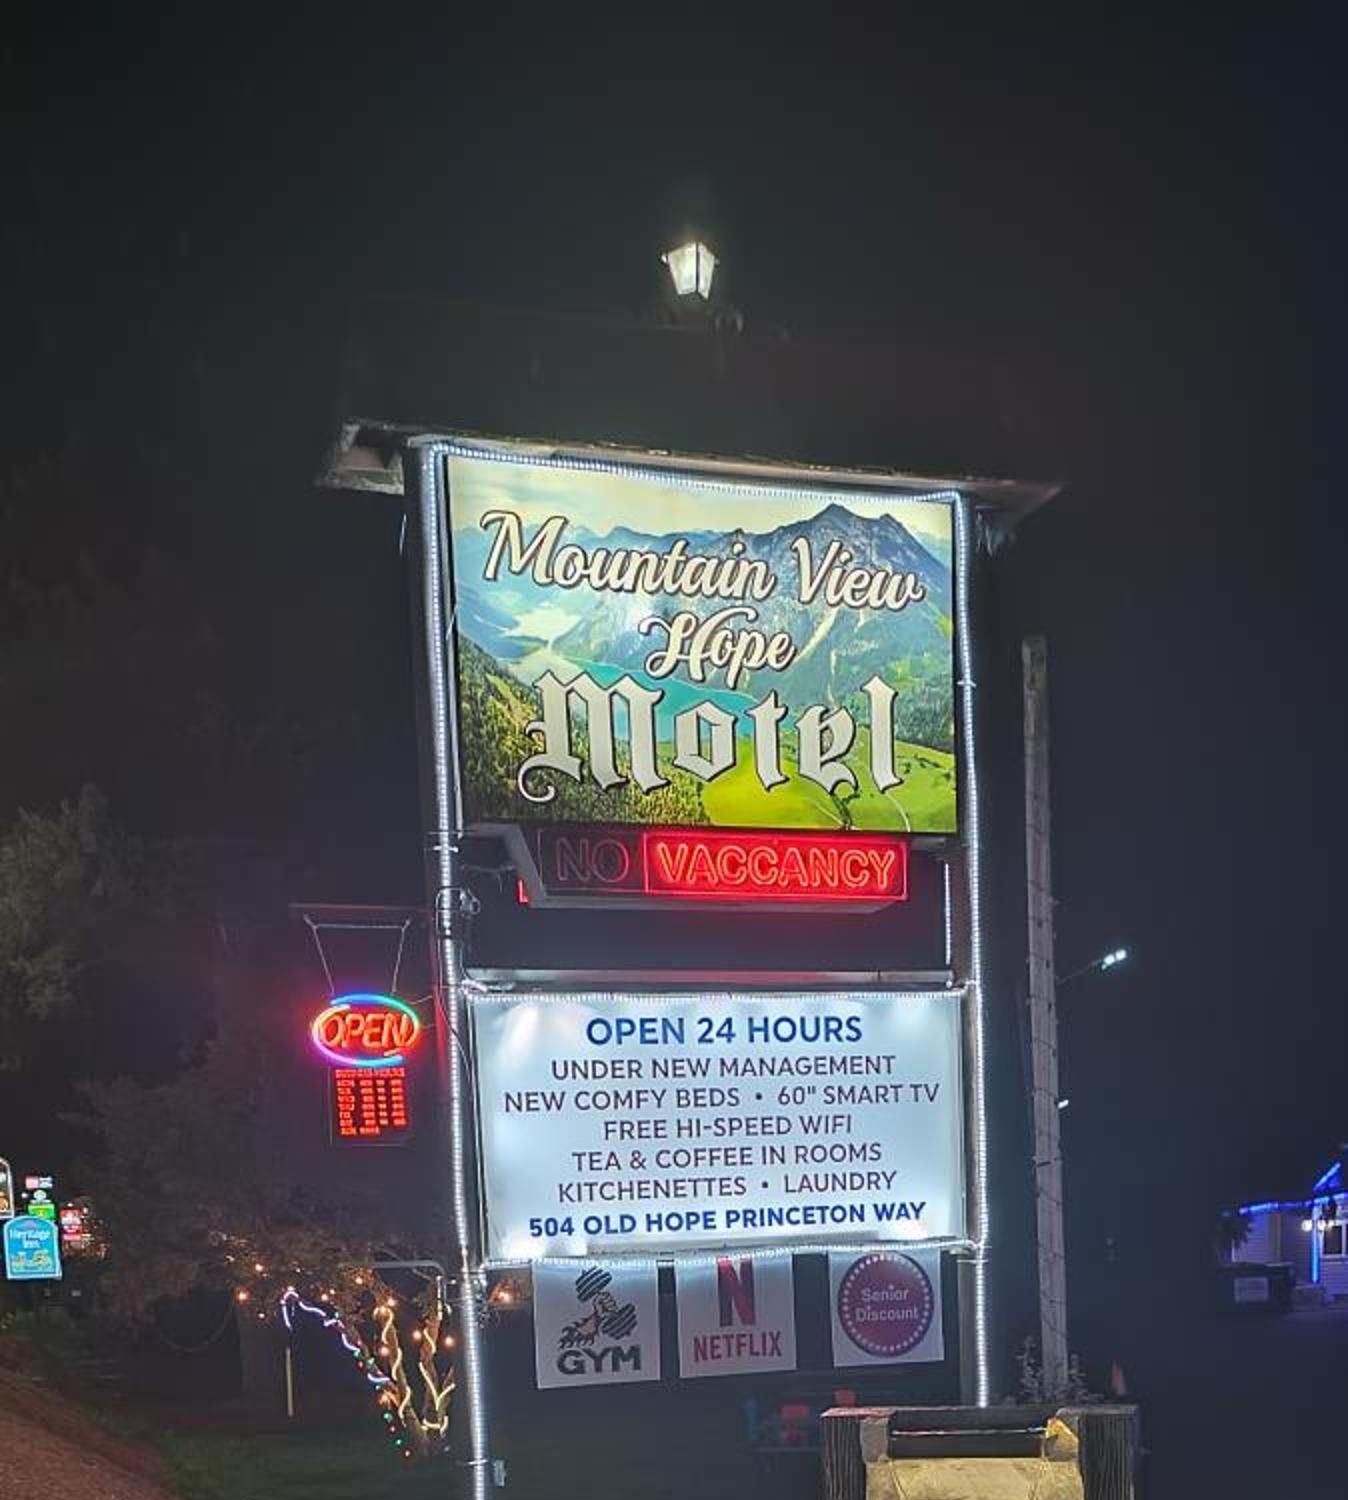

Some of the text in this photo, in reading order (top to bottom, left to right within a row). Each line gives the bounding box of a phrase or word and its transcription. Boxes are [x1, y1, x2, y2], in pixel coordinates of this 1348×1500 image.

[479, 510, 926, 611] Mountain View
[639, 607, 798, 688] Hope
[517, 670, 904, 803] Motel
[557, 838, 897, 890] NO VACCANCY
[321, 1013, 408, 1047] OPEN
[586, 1015, 863, 1045] OPEN 24 HOURS
[551, 1055, 896, 1080] UNDER NEW MANAGEMENT
[504, 1083, 940, 1113] NEW COMFY BEDS 60" SMART TV
[603, 1114, 852, 1140] FREE HI-SPEED WIFI
[571, 1143, 882, 1172] TEA & COFFEE IN ROOMS
[558, 1170, 897, 1203] KITCHENETTES LAUNDRY
[528, 1201, 927, 1238] 504 OLD HOPE PRINCETON WAY
[860, 1286, 910, 1303] Senior
[855, 1304, 920, 1323] Discount
[556, 1343, 642, 1376] GYM
[692, 1330, 783, 1364] NETFLIX
